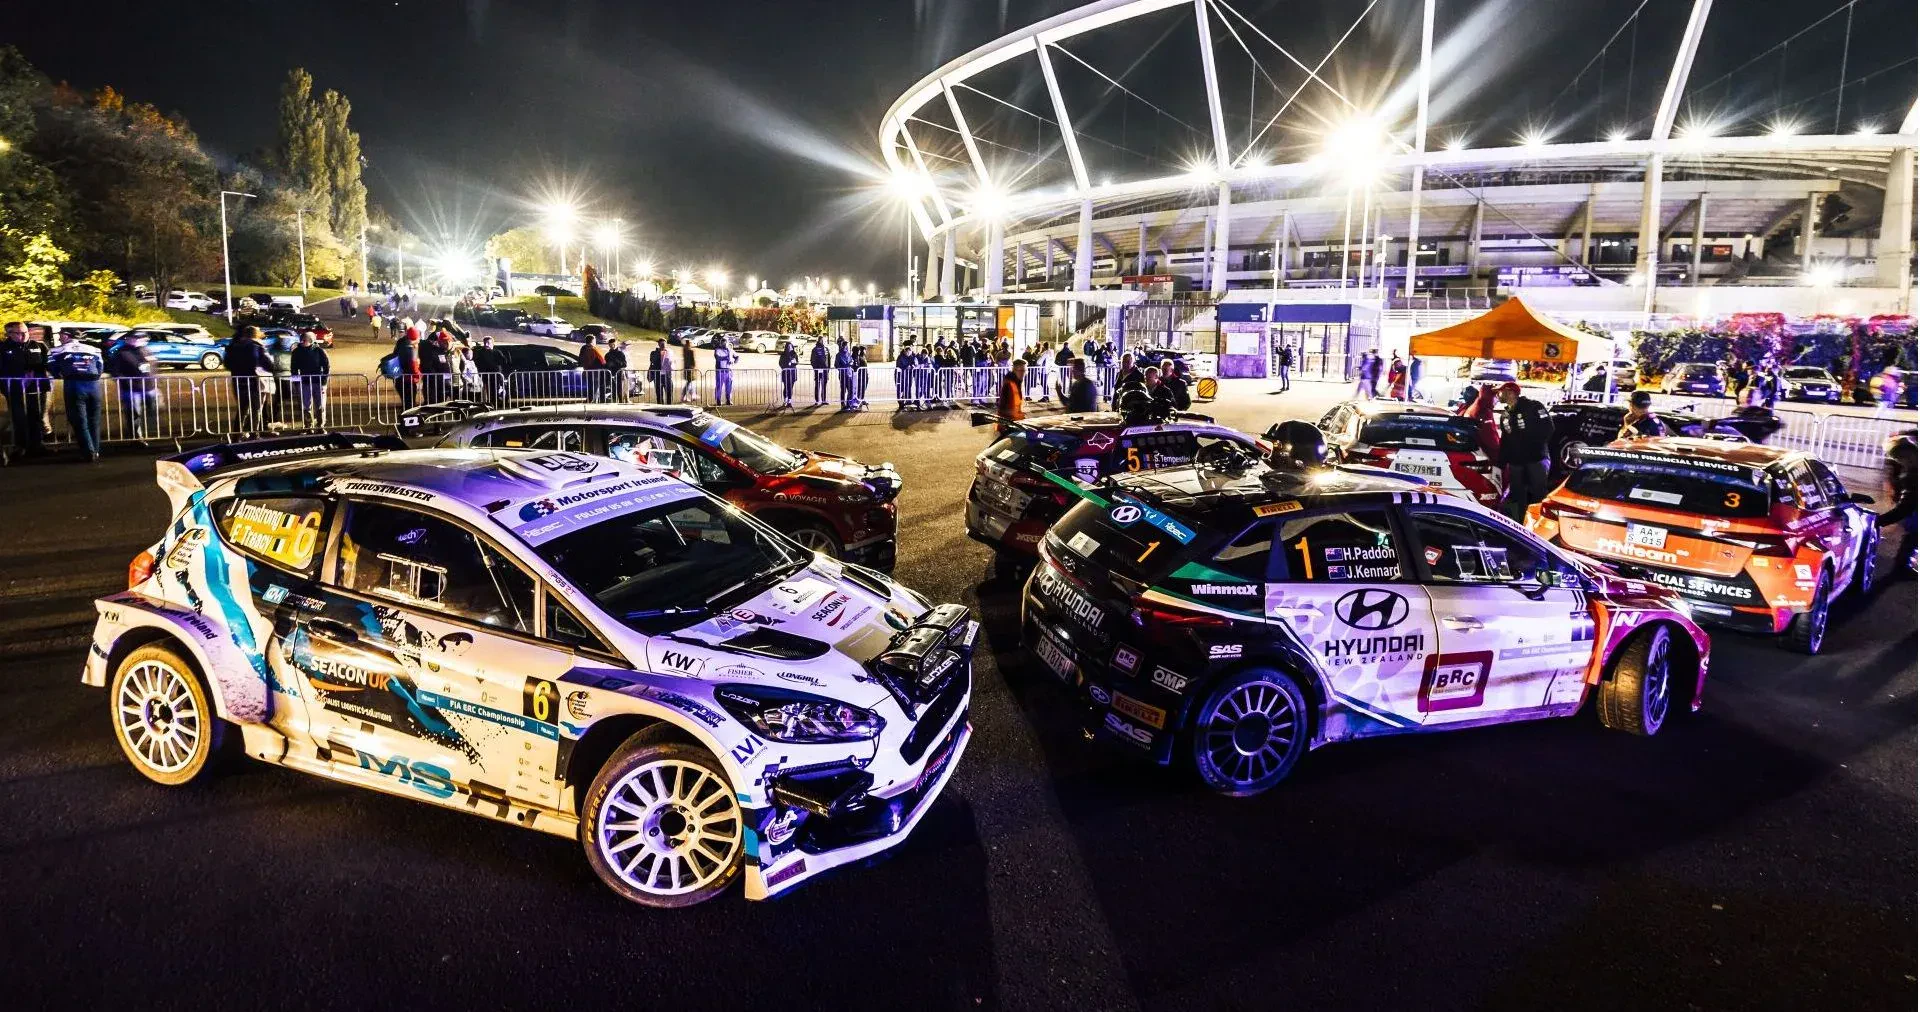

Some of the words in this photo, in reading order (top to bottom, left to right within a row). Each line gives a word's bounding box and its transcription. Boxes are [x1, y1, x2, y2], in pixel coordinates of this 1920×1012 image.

[1259, 307, 1267, 321] 1
[237, 443, 326, 460] Motorsport
[1127, 448, 1140, 472] 5
[1578, 448, 1639, 459] VOLKSWAGEN
[1641, 455, 1691, 466] FINANCIAL
[1693, 460, 1740, 472] SERVICES
[344, 482, 436, 502] THRUSTMASTER
[556, 481, 632, 507] Motorsport
[630, 476, 668, 488] Ireland
[1723, 492, 1741, 508] 3
[226, 498, 239, 517] J
[237, 498, 284, 532] Armstrong
[574, 506, 610, 520] FOLLOW
[1261, 502, 1295, 514] PIRELLI
[242, 526, 274, 555] Treacy
[294, 511, 321, 559] 6
[1640, 527, 1653, 536] AA
[1641, 537, 1662, 547] 015
[1137, 541, 1160, 563] 1
[1295, 536, 1314, 580] 1
[1343, 547, 1395, 561] H.Paddon
[1346, 565, 1400, 580] J.Kennard
[1689, 578, 1752, 599] SERVICES
[811, 600, 842, 622] SEACON
[1053, 580, 1105, 628] HYUNDAI
[185, 612, 218, 640] Ireland
[1209, 644, 1244, 655] SAS
[1324, 635, 1424, 657] HYUNDAI
[661, 650, 696, 671] KW
[1361, 653, 1424, 665] ZEALAND
[310, 655, 368, 686] SEACON
[368, 672, 391, 692] UK
[779, 671, 820, 685] LONGHILL
[1153, 669, 1187, 690] OMP
[1436, 669, 1475, 688] BRC
[533, 681, 551, 721] 6
[450, 700, 463, 712] FIA
[463, 703, 477, 714] ERC
[477, 707, 526, 728] Championship
[1104, 713, 1153, 744] SAS
[730, 733, 764, 765] LVI
[588, 784, 607, 833] ZERO
